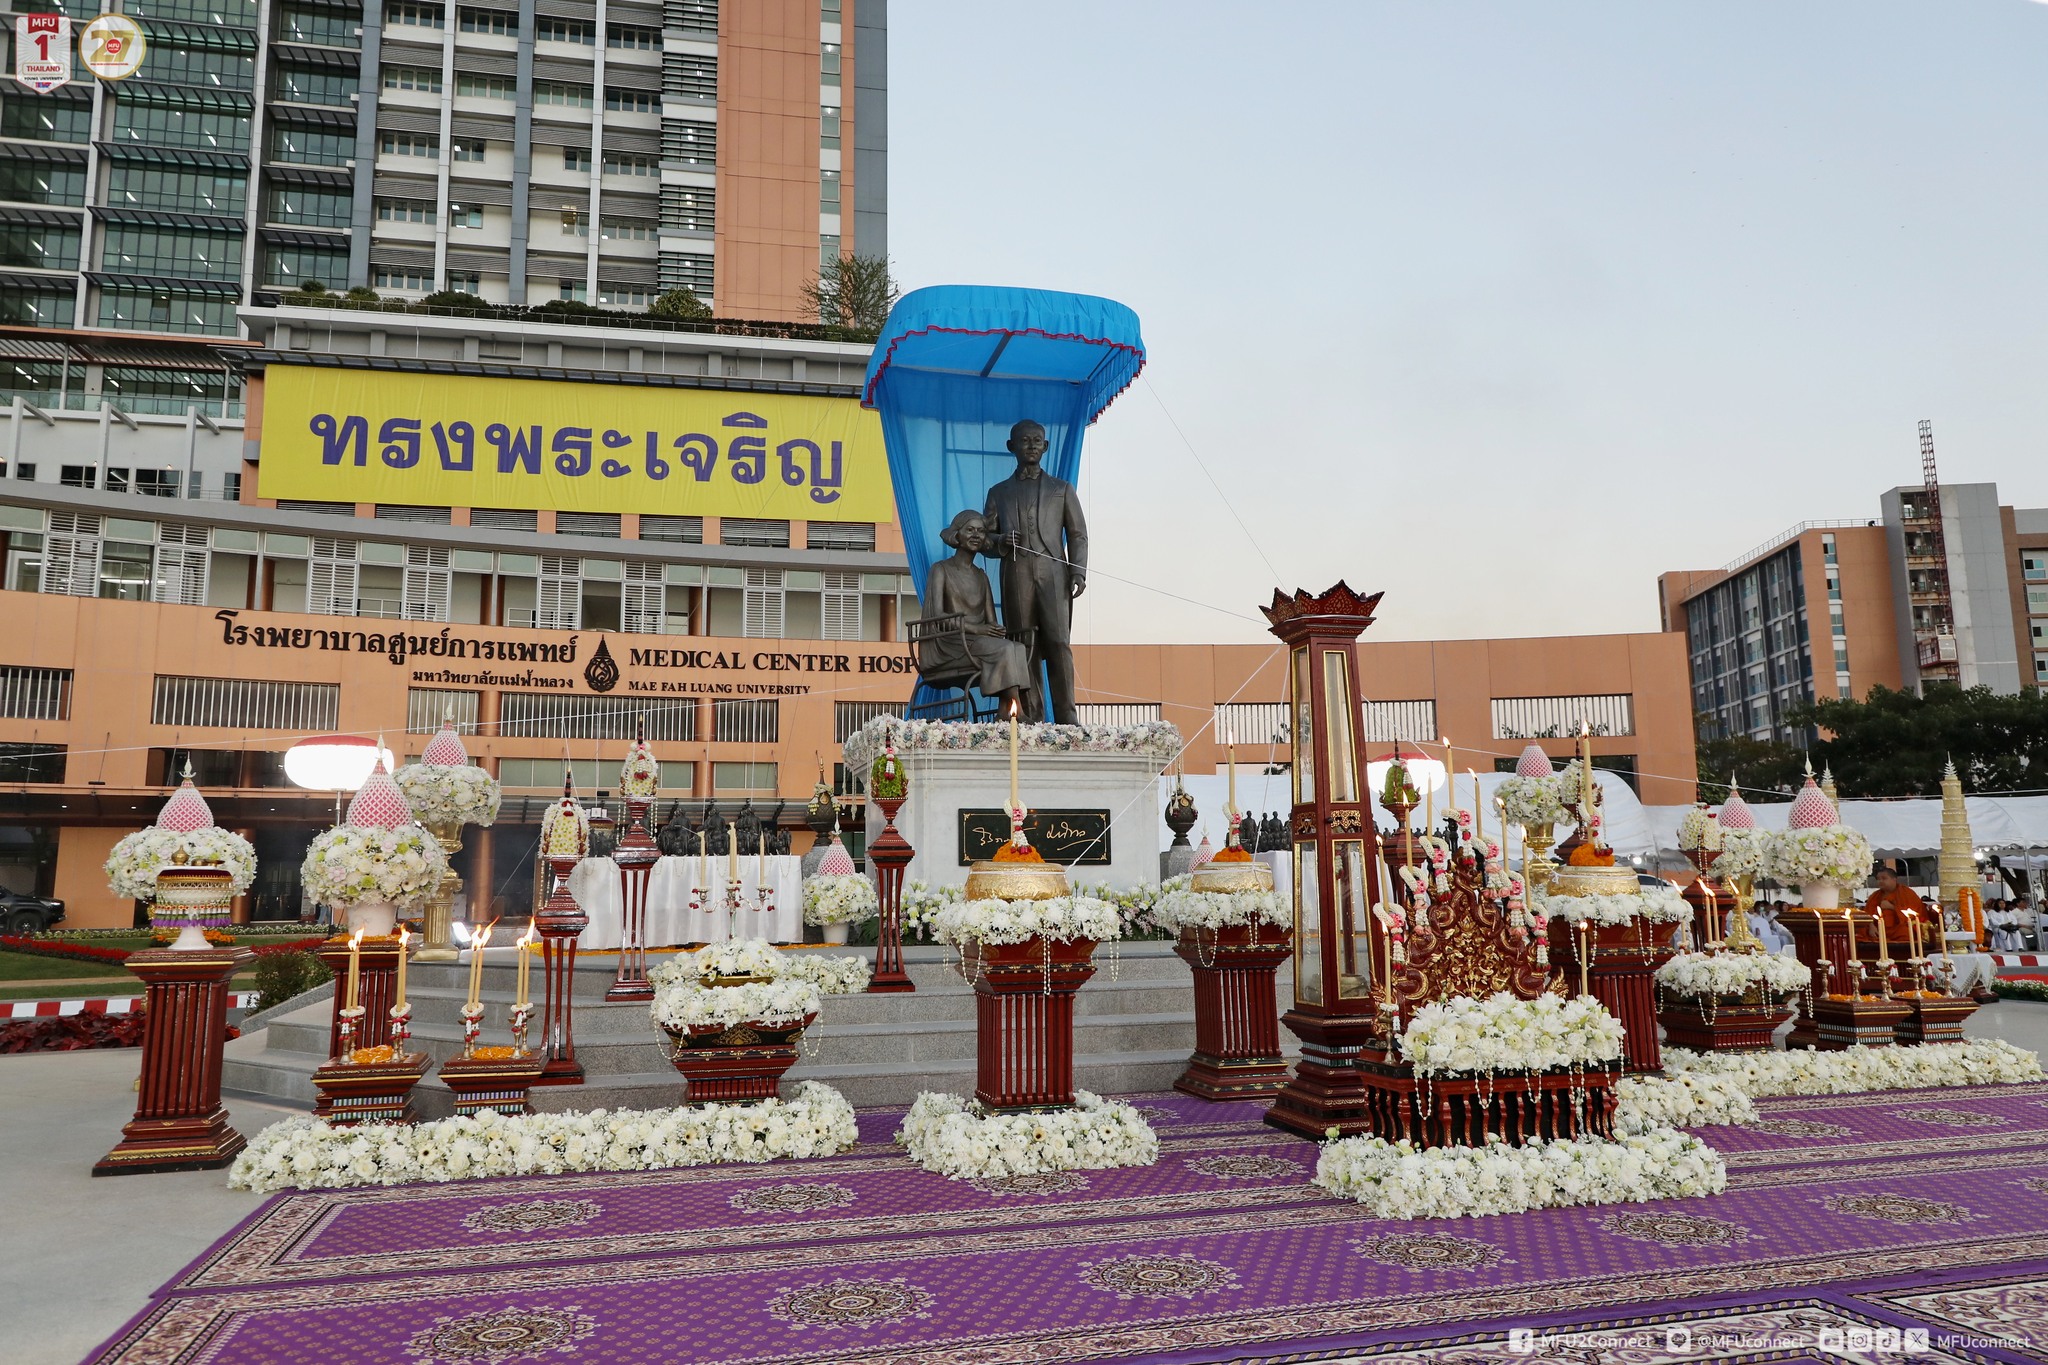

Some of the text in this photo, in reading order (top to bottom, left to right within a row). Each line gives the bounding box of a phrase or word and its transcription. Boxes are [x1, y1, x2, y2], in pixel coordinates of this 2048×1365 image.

[309, 411, 843, 504] ทรงพระเจริญ
[214, 609, 578, 666] โรงพยาบาลศูนย์การแพทย์
[629, 648, 746, 670] MEDICAL
[752, 652, 851, 673] CENTER
[412, 668, 575, 690] มหาวิทยาลัยแม่ฟ้าหลวง
[628, 680, 811, 695] MAE FAH LUANG UNIVERSITY
